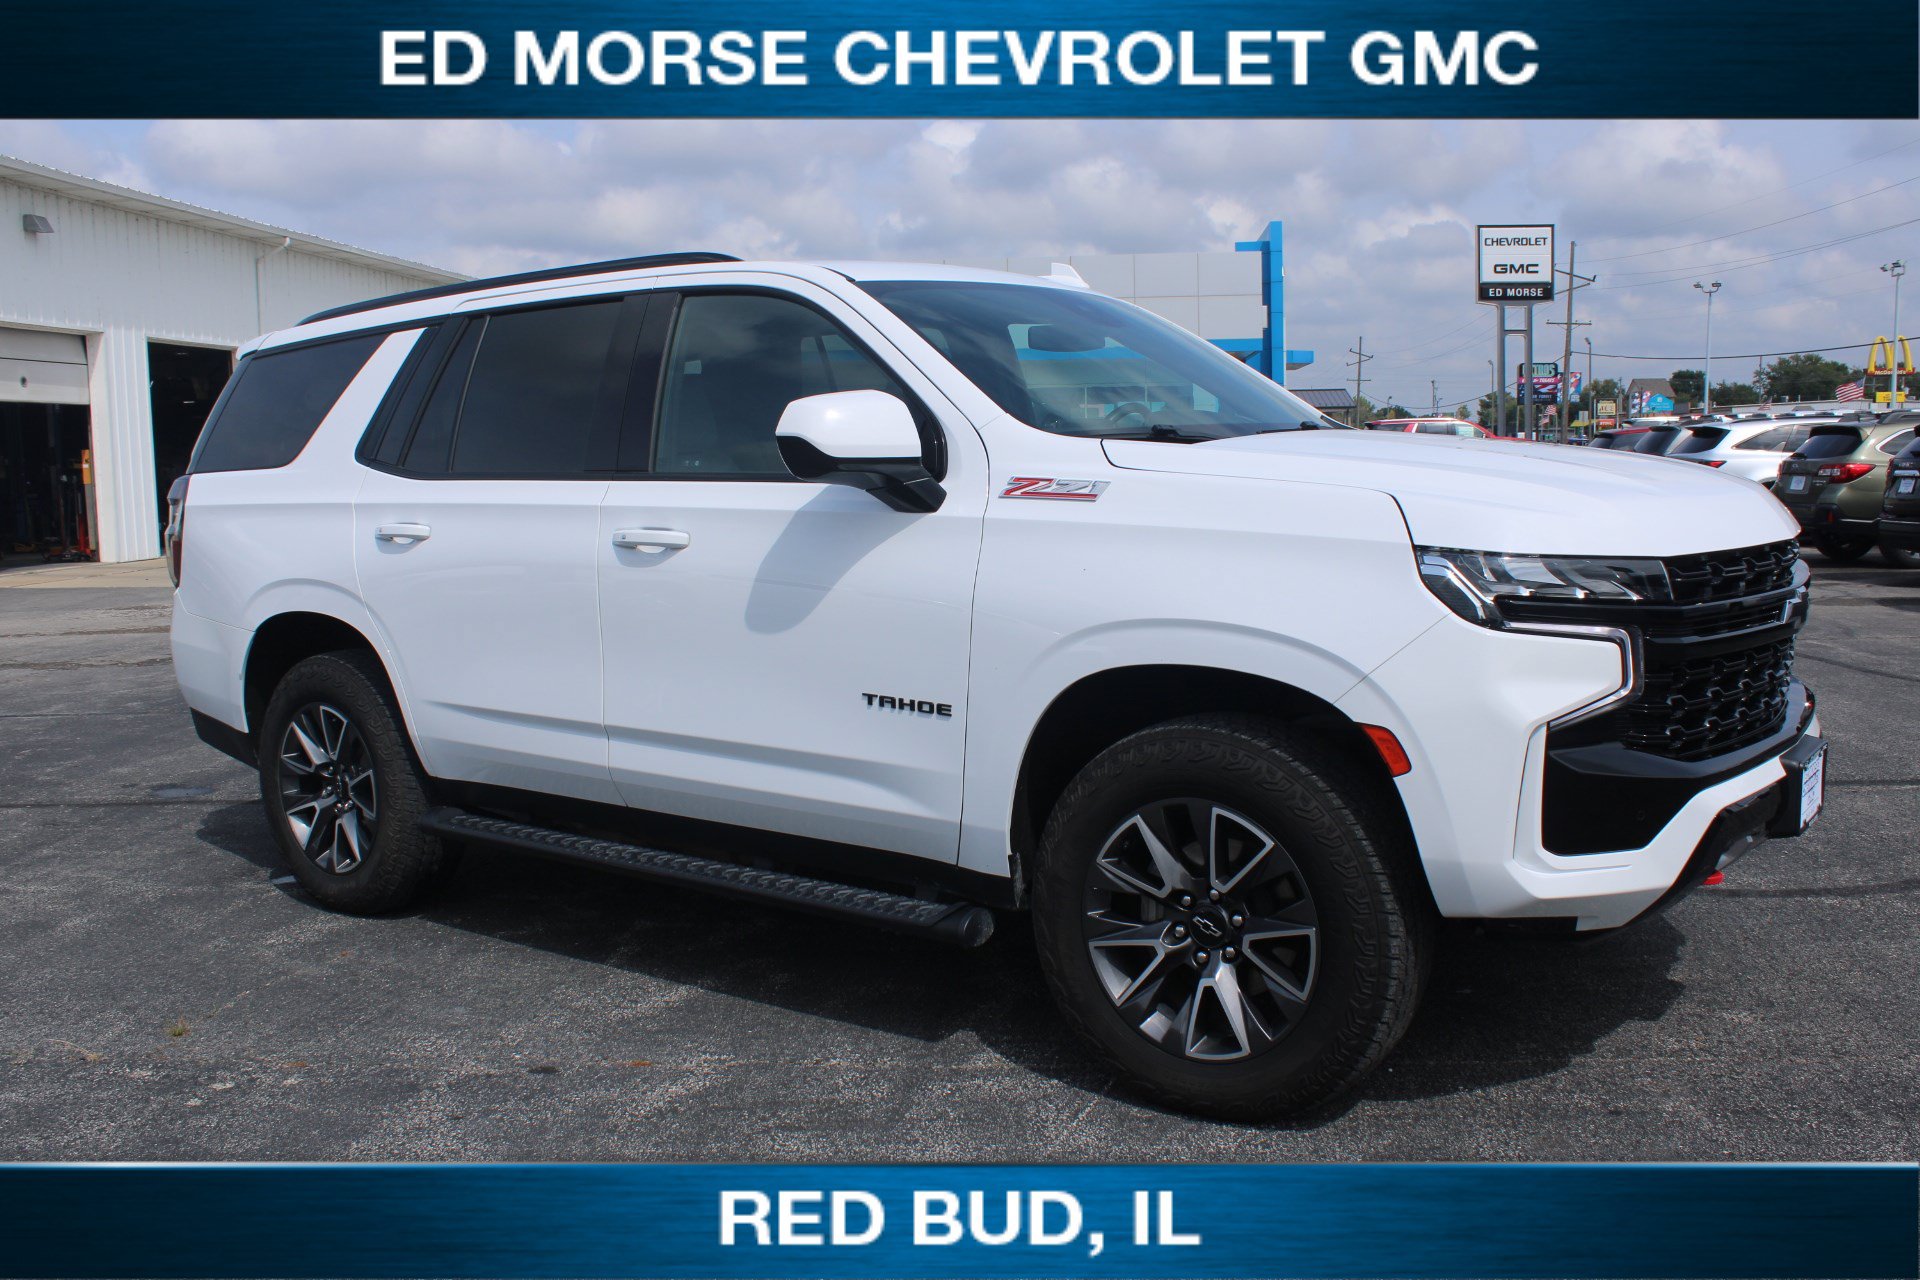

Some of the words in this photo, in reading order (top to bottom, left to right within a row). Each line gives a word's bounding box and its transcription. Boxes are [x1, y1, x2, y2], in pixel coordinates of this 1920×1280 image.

[1484, 237, 1548, 247] CHEVROLET
[1493, 263, 1539, 274] GMC
[1488, 287, 1503, 297] ED
[1506, 287, 1544, 297] MORSE
[999, 476, 1112, 502] Z71
[862, 693, 952, 717] TAHOE
